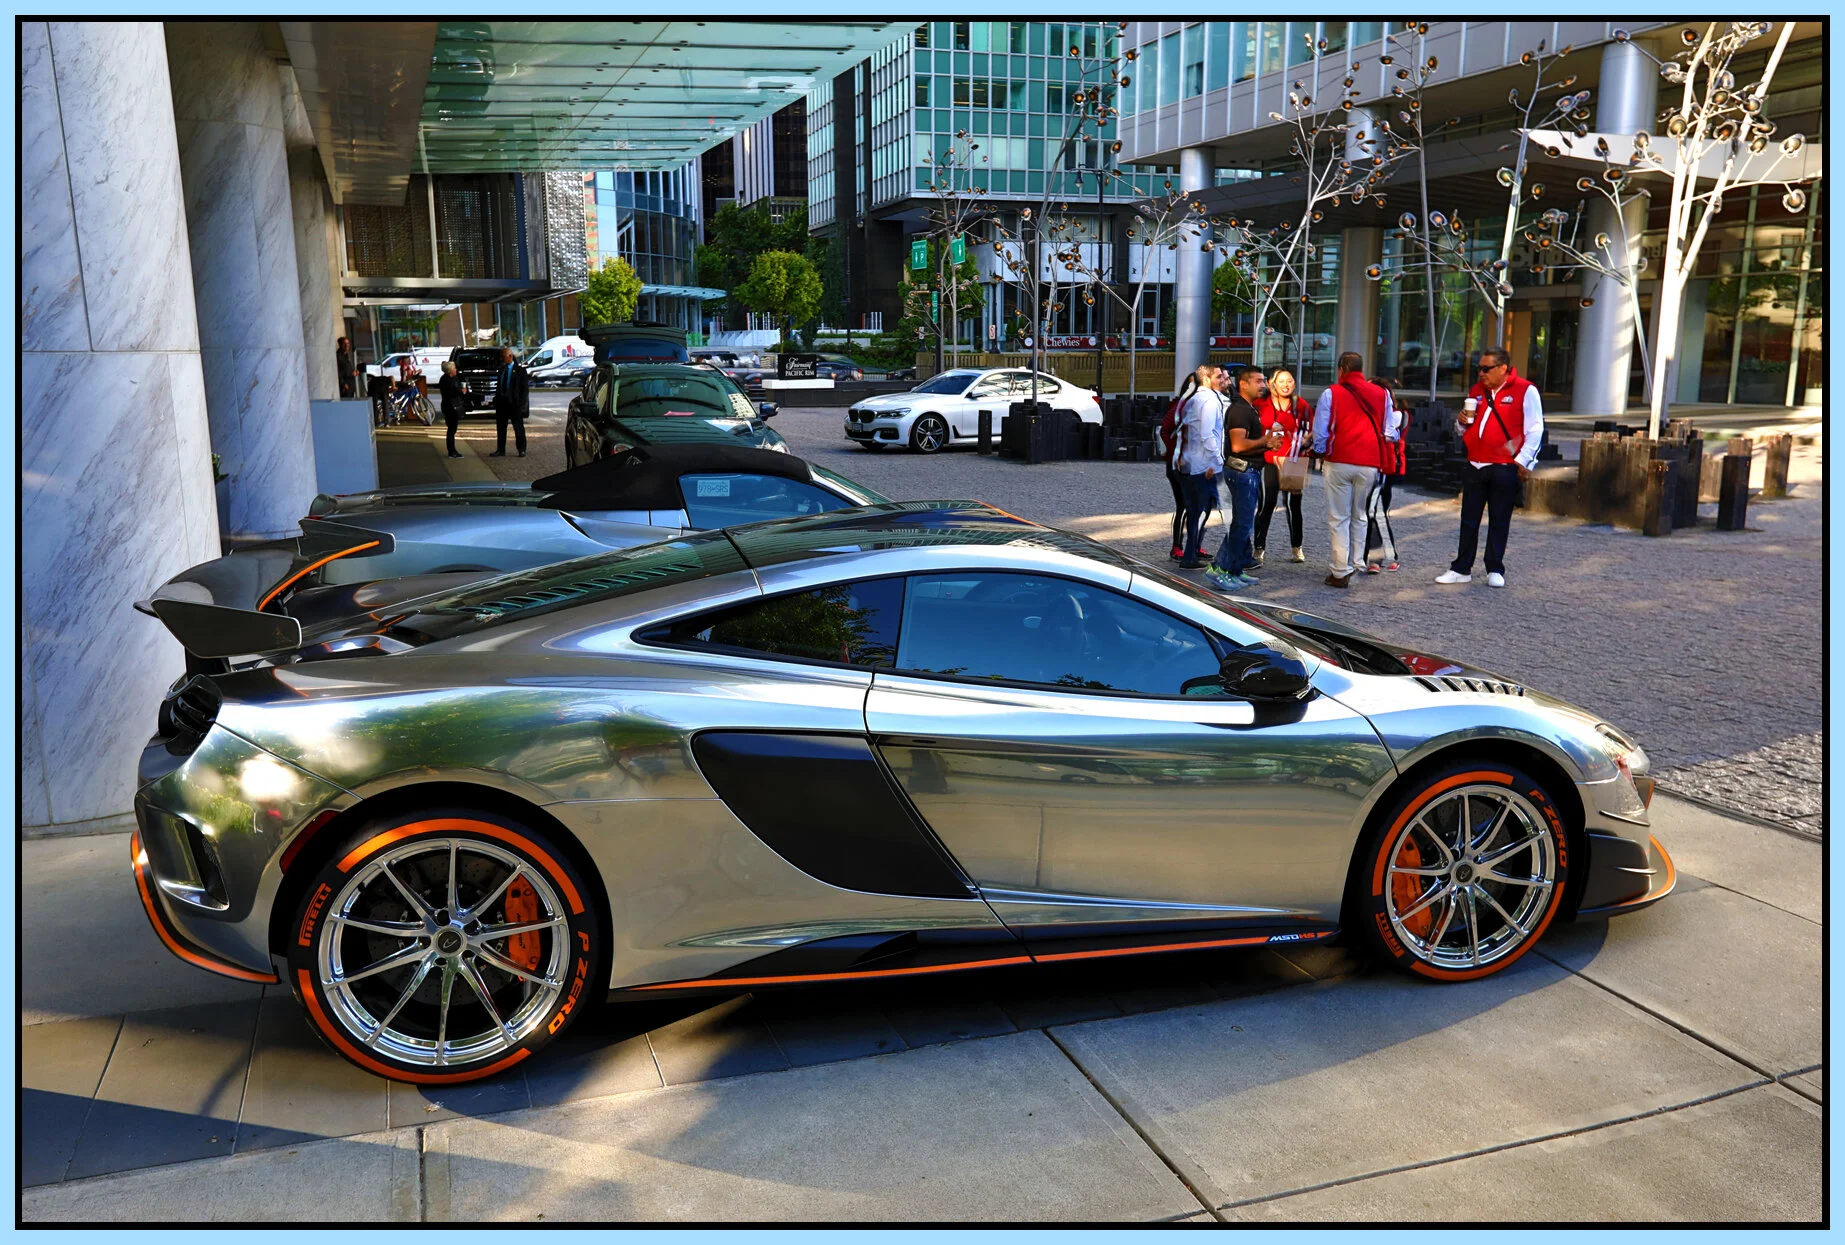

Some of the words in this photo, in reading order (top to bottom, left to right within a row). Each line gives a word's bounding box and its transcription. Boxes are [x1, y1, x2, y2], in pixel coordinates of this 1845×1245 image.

[786, 357, 813, 370] Fairmont
[1045, 337, 1080, 347] Chewies
[1529, 789, 1545, 802] P
[1543, 804, 1567, 868] ZERO
[298, 882, 332, 947] PIRELLI
[1375, 912, 1405, 958] PIRELLI
[577, 930, 590, 952] P
[548, 957, 588, 1035] ZERO
